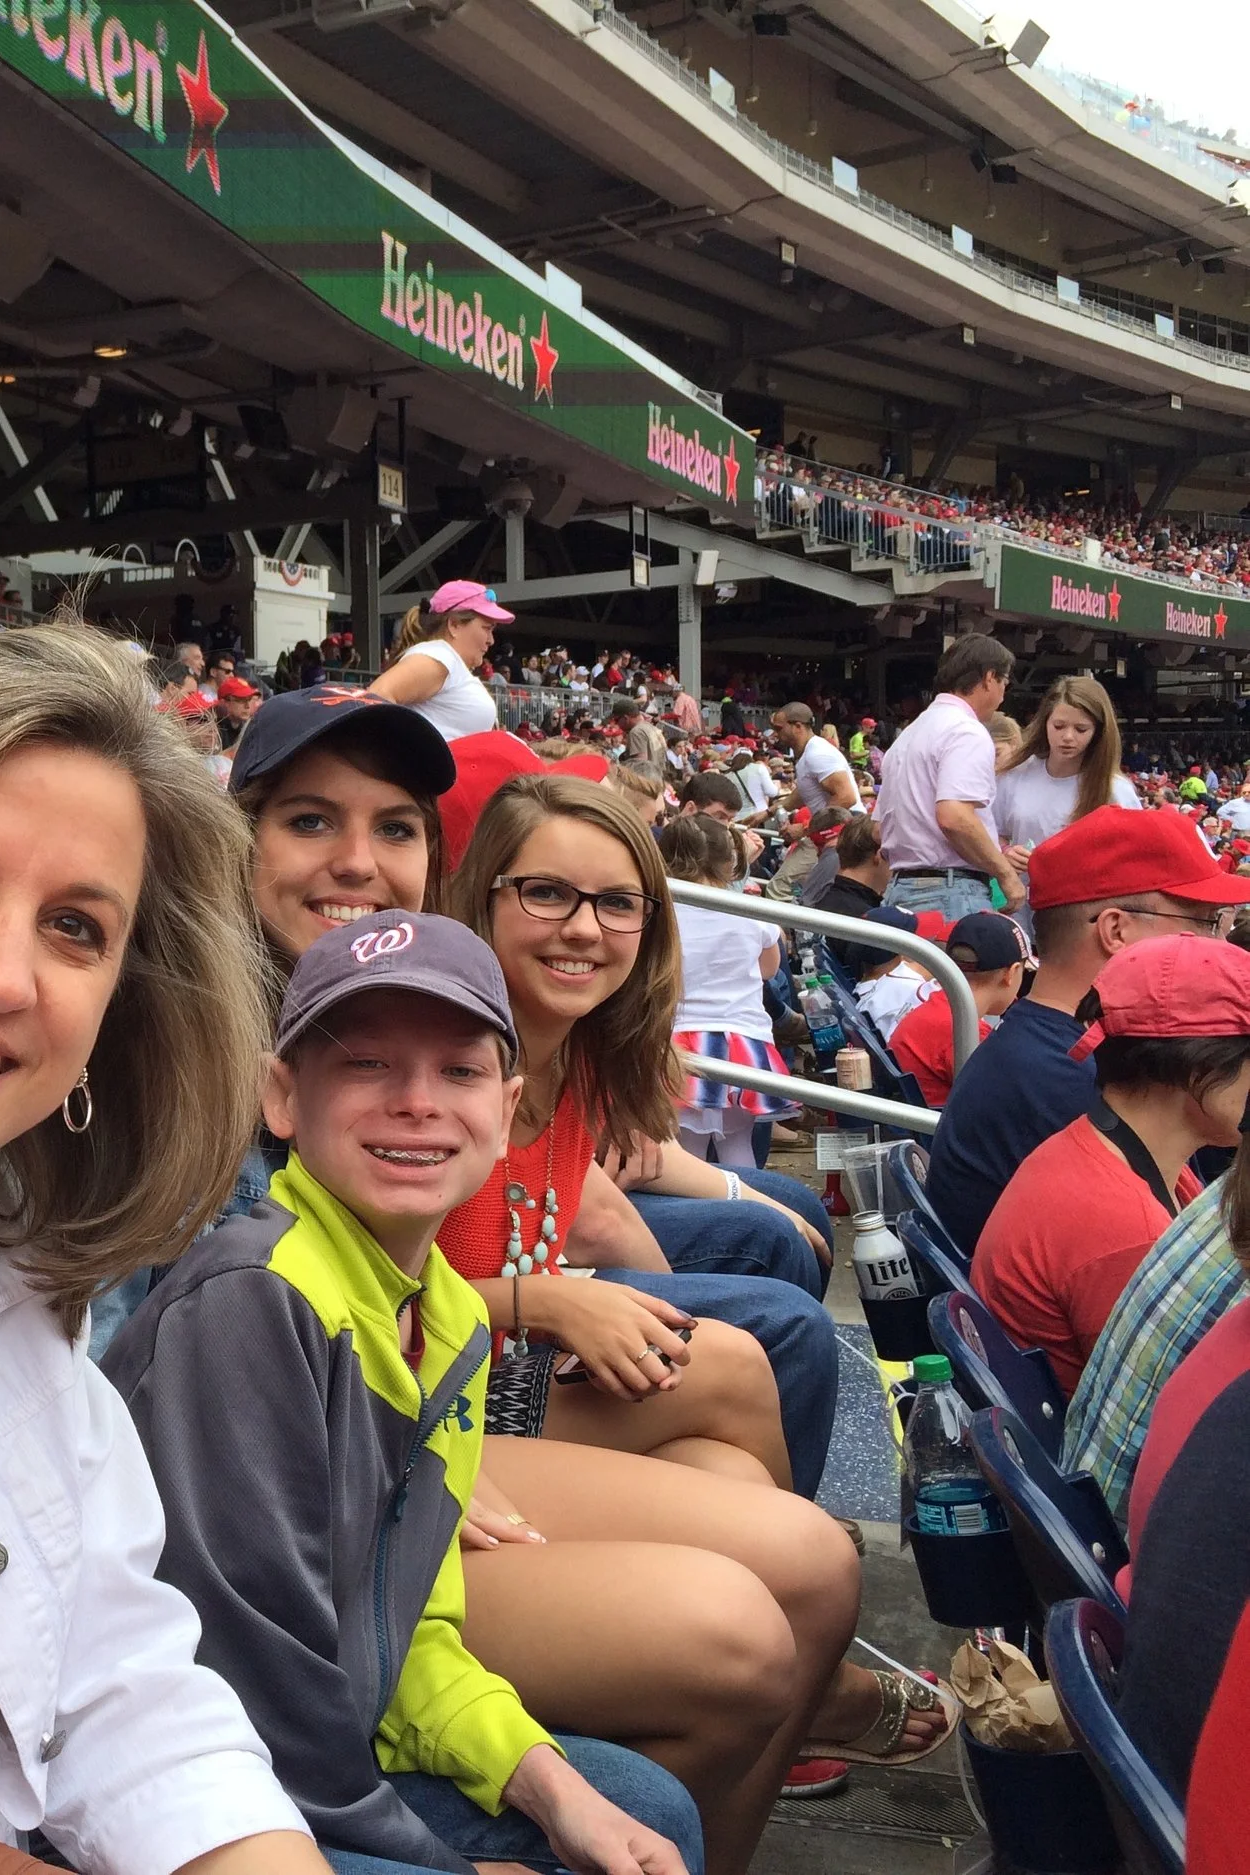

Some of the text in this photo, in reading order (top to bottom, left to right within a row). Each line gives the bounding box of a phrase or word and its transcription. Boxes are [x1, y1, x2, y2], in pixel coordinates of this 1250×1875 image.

[380, 230, 525, 392] Heineken
[647, 400, 722, 497] Heineken
[382, 472, 400, 499] 114
[1051, 575, 1107, 620] Heineken
[1165, 601, 1212, 639] Heineken
[866, 1257, 910, 1287] Lite
